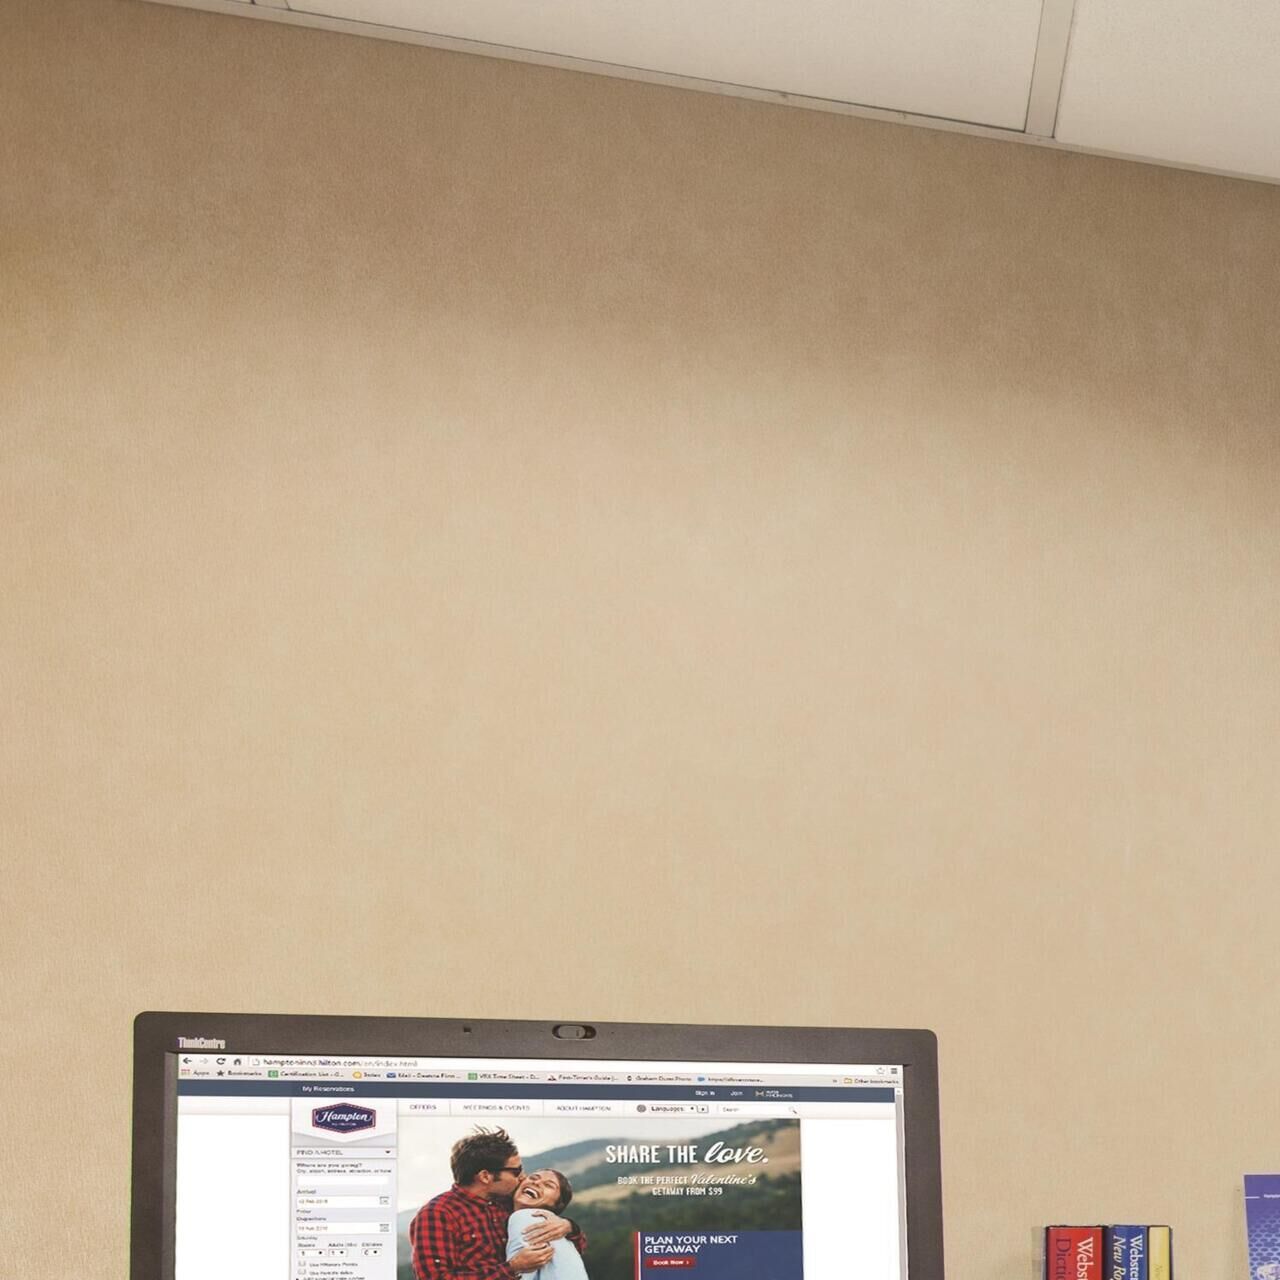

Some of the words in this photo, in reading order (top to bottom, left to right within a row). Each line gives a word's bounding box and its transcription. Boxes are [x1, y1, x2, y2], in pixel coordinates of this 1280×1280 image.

[316, 1111, 372, 1122] Hampton
[606, 1145, 660, 1163] SHARE
[667, 1145, 698, 1163] THE
[704, 1142, 769, 1164] love.
[618, 1177, 638, 1185] BOOK
[640, 1177, 653, 1185] THE
[656, 1176, 688, 1185] PERFECT
[690, 1173, 756, 1185] Valentine's
[652, 1187, 684, 1196] GETAWAY
[686, 1187, 706, 1196] FROM
[708, 1187, 723, 1196] $99
[645, 1236, 673, 1244] PLAN
[676, 1236, 707, 1244] YOUR
[710, 1235, 738, 1244] NEXT
[645, 1245, 701, 1253] GETAWAY
[1113, 1235, 1126, 1263] New
